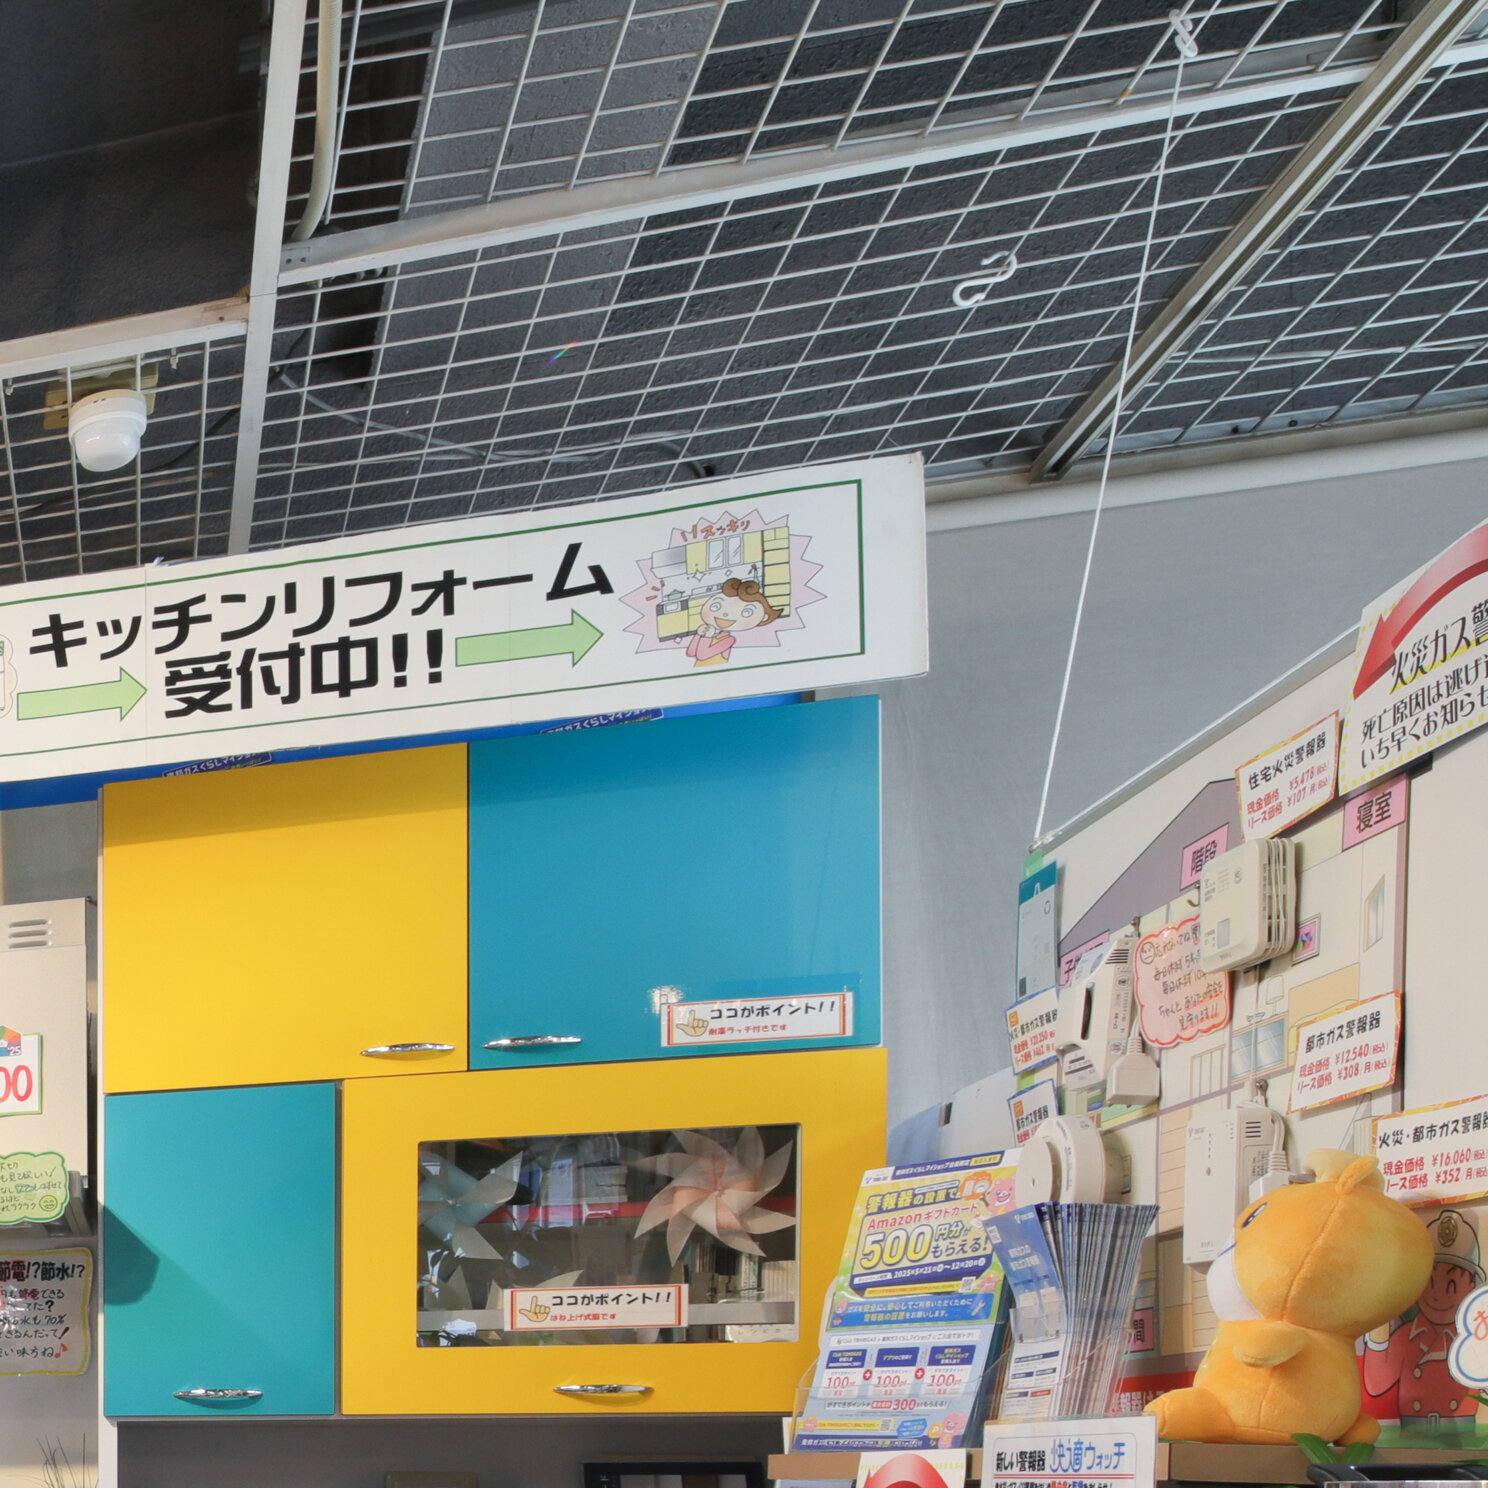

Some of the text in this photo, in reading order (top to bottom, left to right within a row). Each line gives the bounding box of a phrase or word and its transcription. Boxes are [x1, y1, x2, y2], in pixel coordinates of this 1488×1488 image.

[28, 543, 615, 669] キッチンリフォーム
[162, 627, 447, 719] 受付中!!
[1248, 731, 1327, 791] 住宅火災警報器
[1247, 788, 1280, 815] 現金価格
[1356, 791, 1392, 834] 寝室
[1248, 802, 1283, 828] リース価格
[710, 1001, 836, 1019] ココがポイント!!
[1305, 1012, 1381, 1054] 都市ガス警報器
[1298, 1057, 1330, 1079] 現金価格
[1297, 1072, 1333, 1093] リース価格
[1383, 1156, 1425, 1176] 現金価格
[1386, 1170, 1428, 1191] リース価格
[867, 1205, 978, 1231] Amazonギフトカード
[860, 1224, 934, 1270] 500
[931, 1236, 988, 1259] もらえる!
[550, 1290, 673, 1308] ココがポイント!!
[995, 1438, 1126, 1473] 新しい警報器 快適ウォッチ
